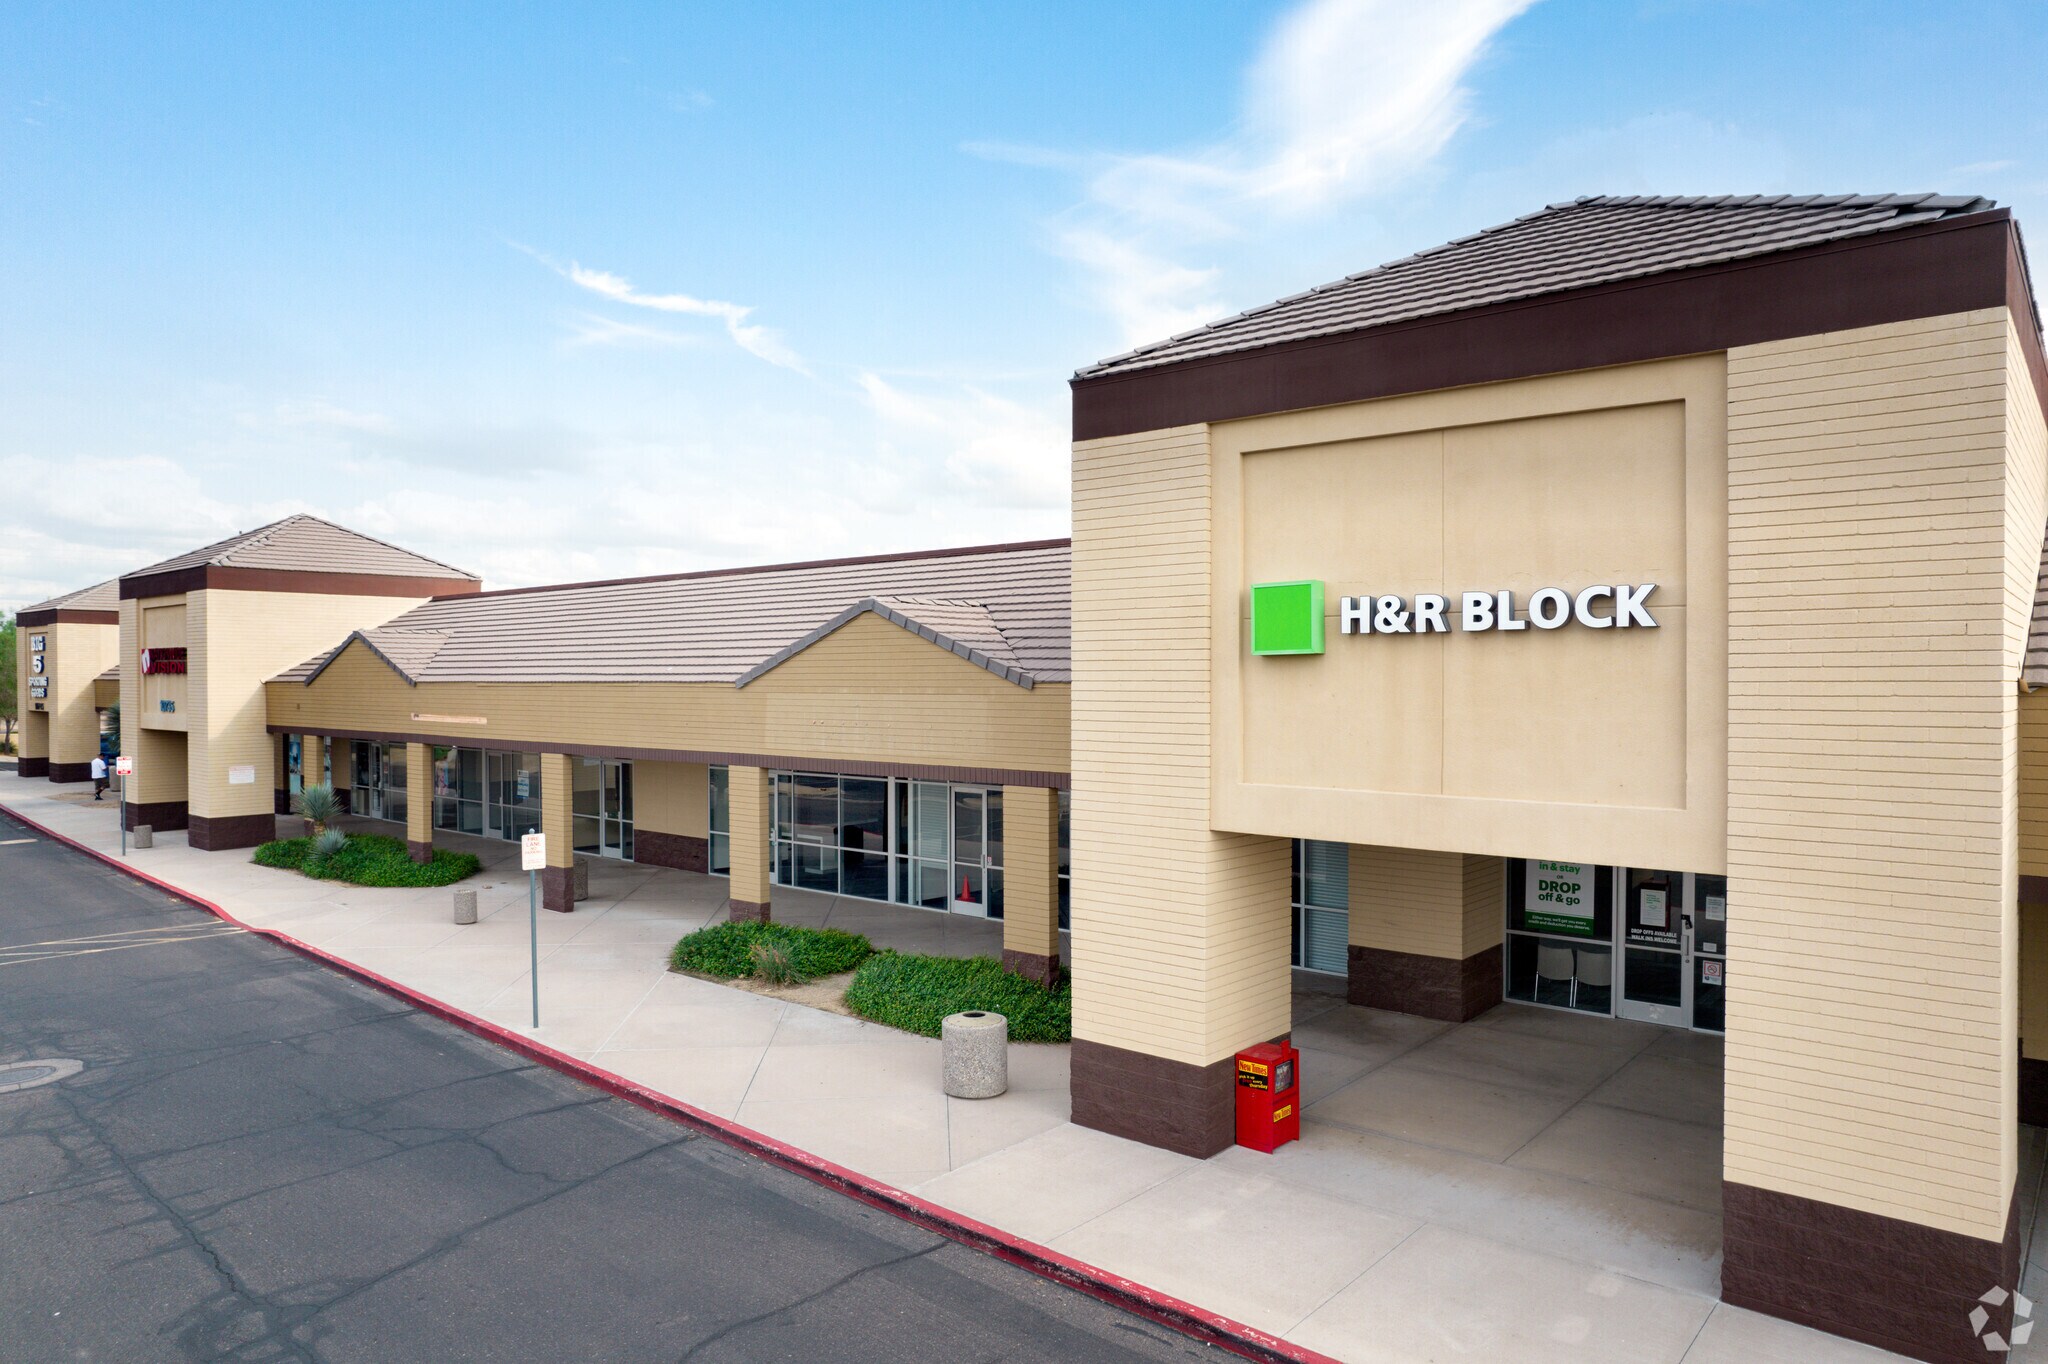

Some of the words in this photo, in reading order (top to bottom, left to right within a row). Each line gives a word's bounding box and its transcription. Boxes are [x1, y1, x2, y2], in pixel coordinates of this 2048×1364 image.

[1340, 593, 1452, 634] H&R
[1462, 583, 1660, 632] BLOCK
[31, 636, 46, 652] BIG
[32, 655, 44, 673] 5
[150, 661, 185, 673] VISION
[1539, 862, 1548, 870] in
[1550, 863, 1558, 871] &
[1560, 864, 1580, 874] stay
[1538, 880, 1581, 894] DROP
[1538, 892, 1554, 901] off
[1555, 894, 1564, 902] &
[1566, 897, 1580, 905] go
[1654, 930, 1677, 938] AVAILABLE
[1240, 1060, 1251, 1072] New
[1252, 1063, 1267, 1076] Times
